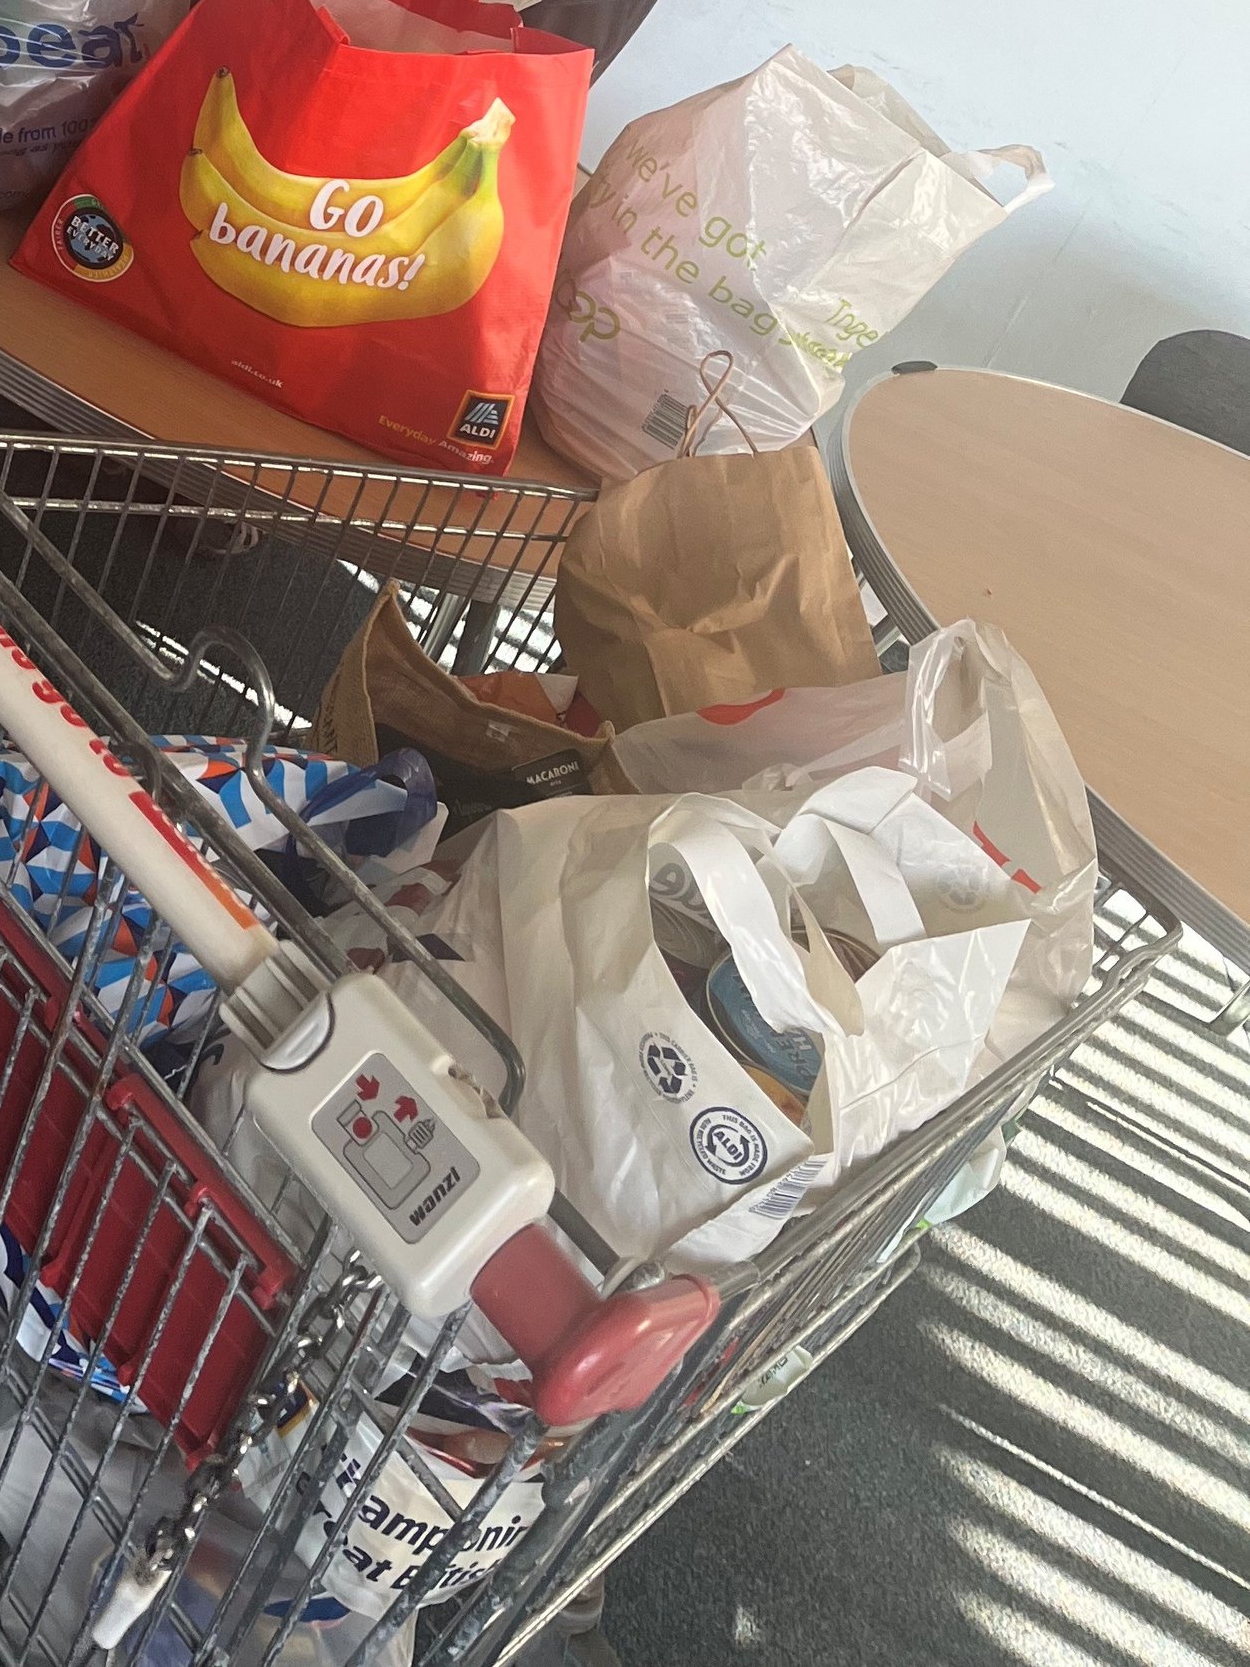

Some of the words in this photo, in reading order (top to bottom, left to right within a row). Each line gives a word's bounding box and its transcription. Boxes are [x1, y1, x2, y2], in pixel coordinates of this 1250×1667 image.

[18, 126, 57, 143] from
[626, 142, 698, 218] we've
[699, 216, 767, 271] got
[66, 226, 114, 262] EVERYDAY
[70, 215, 119, 254] BETTER
[209, 202, 426, 291] bananas!
[612, 194, 638, 235] in
[640, 226, 700, 285] the
[707, 275, 780, 337] bag
[378, 414, 436, 448] Everyday
[459, 423, 496, 439] ALDI
[526, 760, 580, 785] MACARONI
[722, 1114, 738, 1124] THIS
[713, 1130, 743, 1161] ALDI
